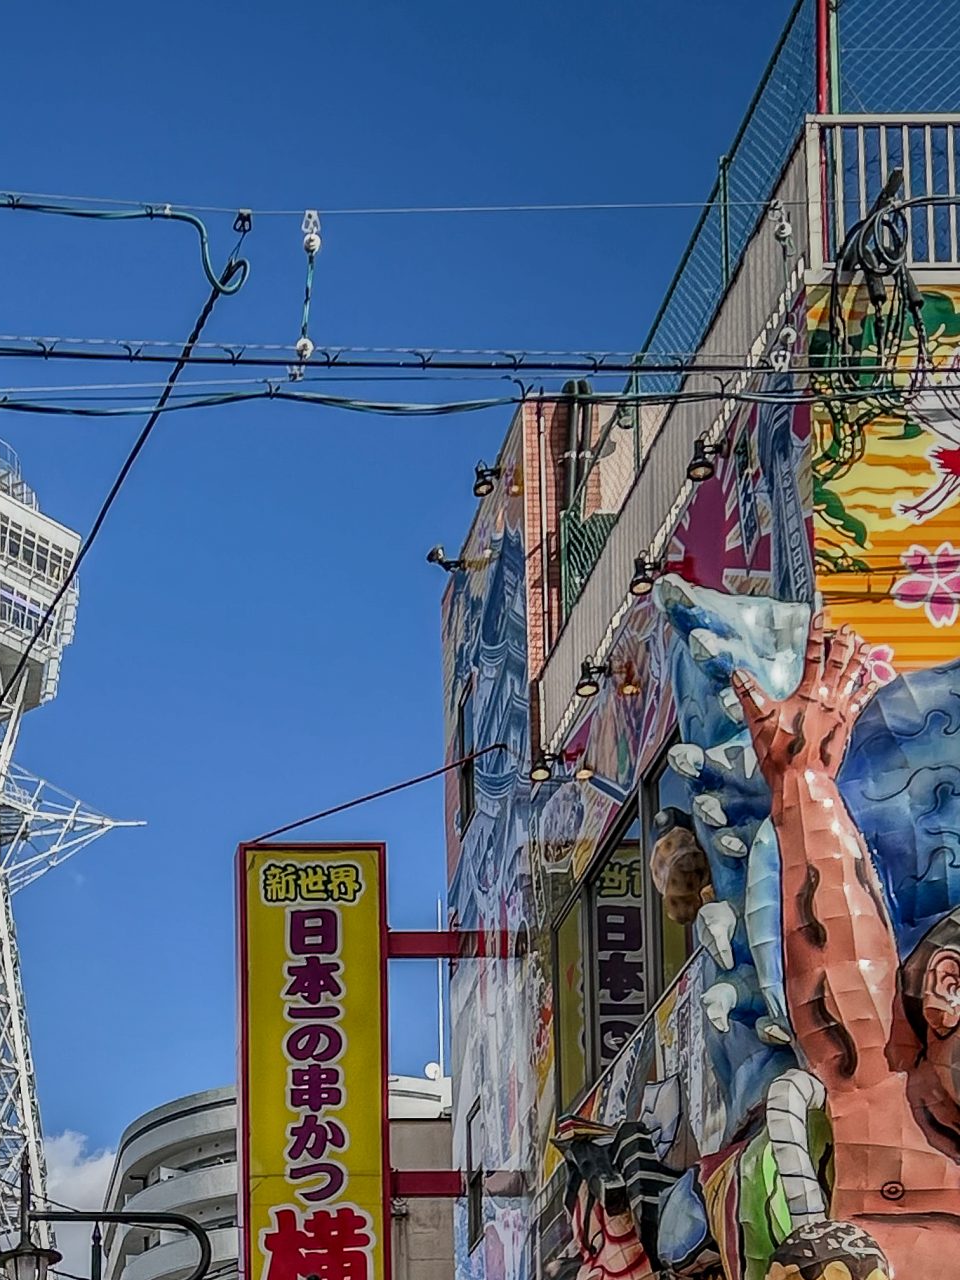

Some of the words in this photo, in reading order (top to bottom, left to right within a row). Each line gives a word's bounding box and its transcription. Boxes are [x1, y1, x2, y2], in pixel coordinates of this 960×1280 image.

[263, 863, 362, 902] 新世界
[287, 909, 346, 1202] 日本一の串かつ
